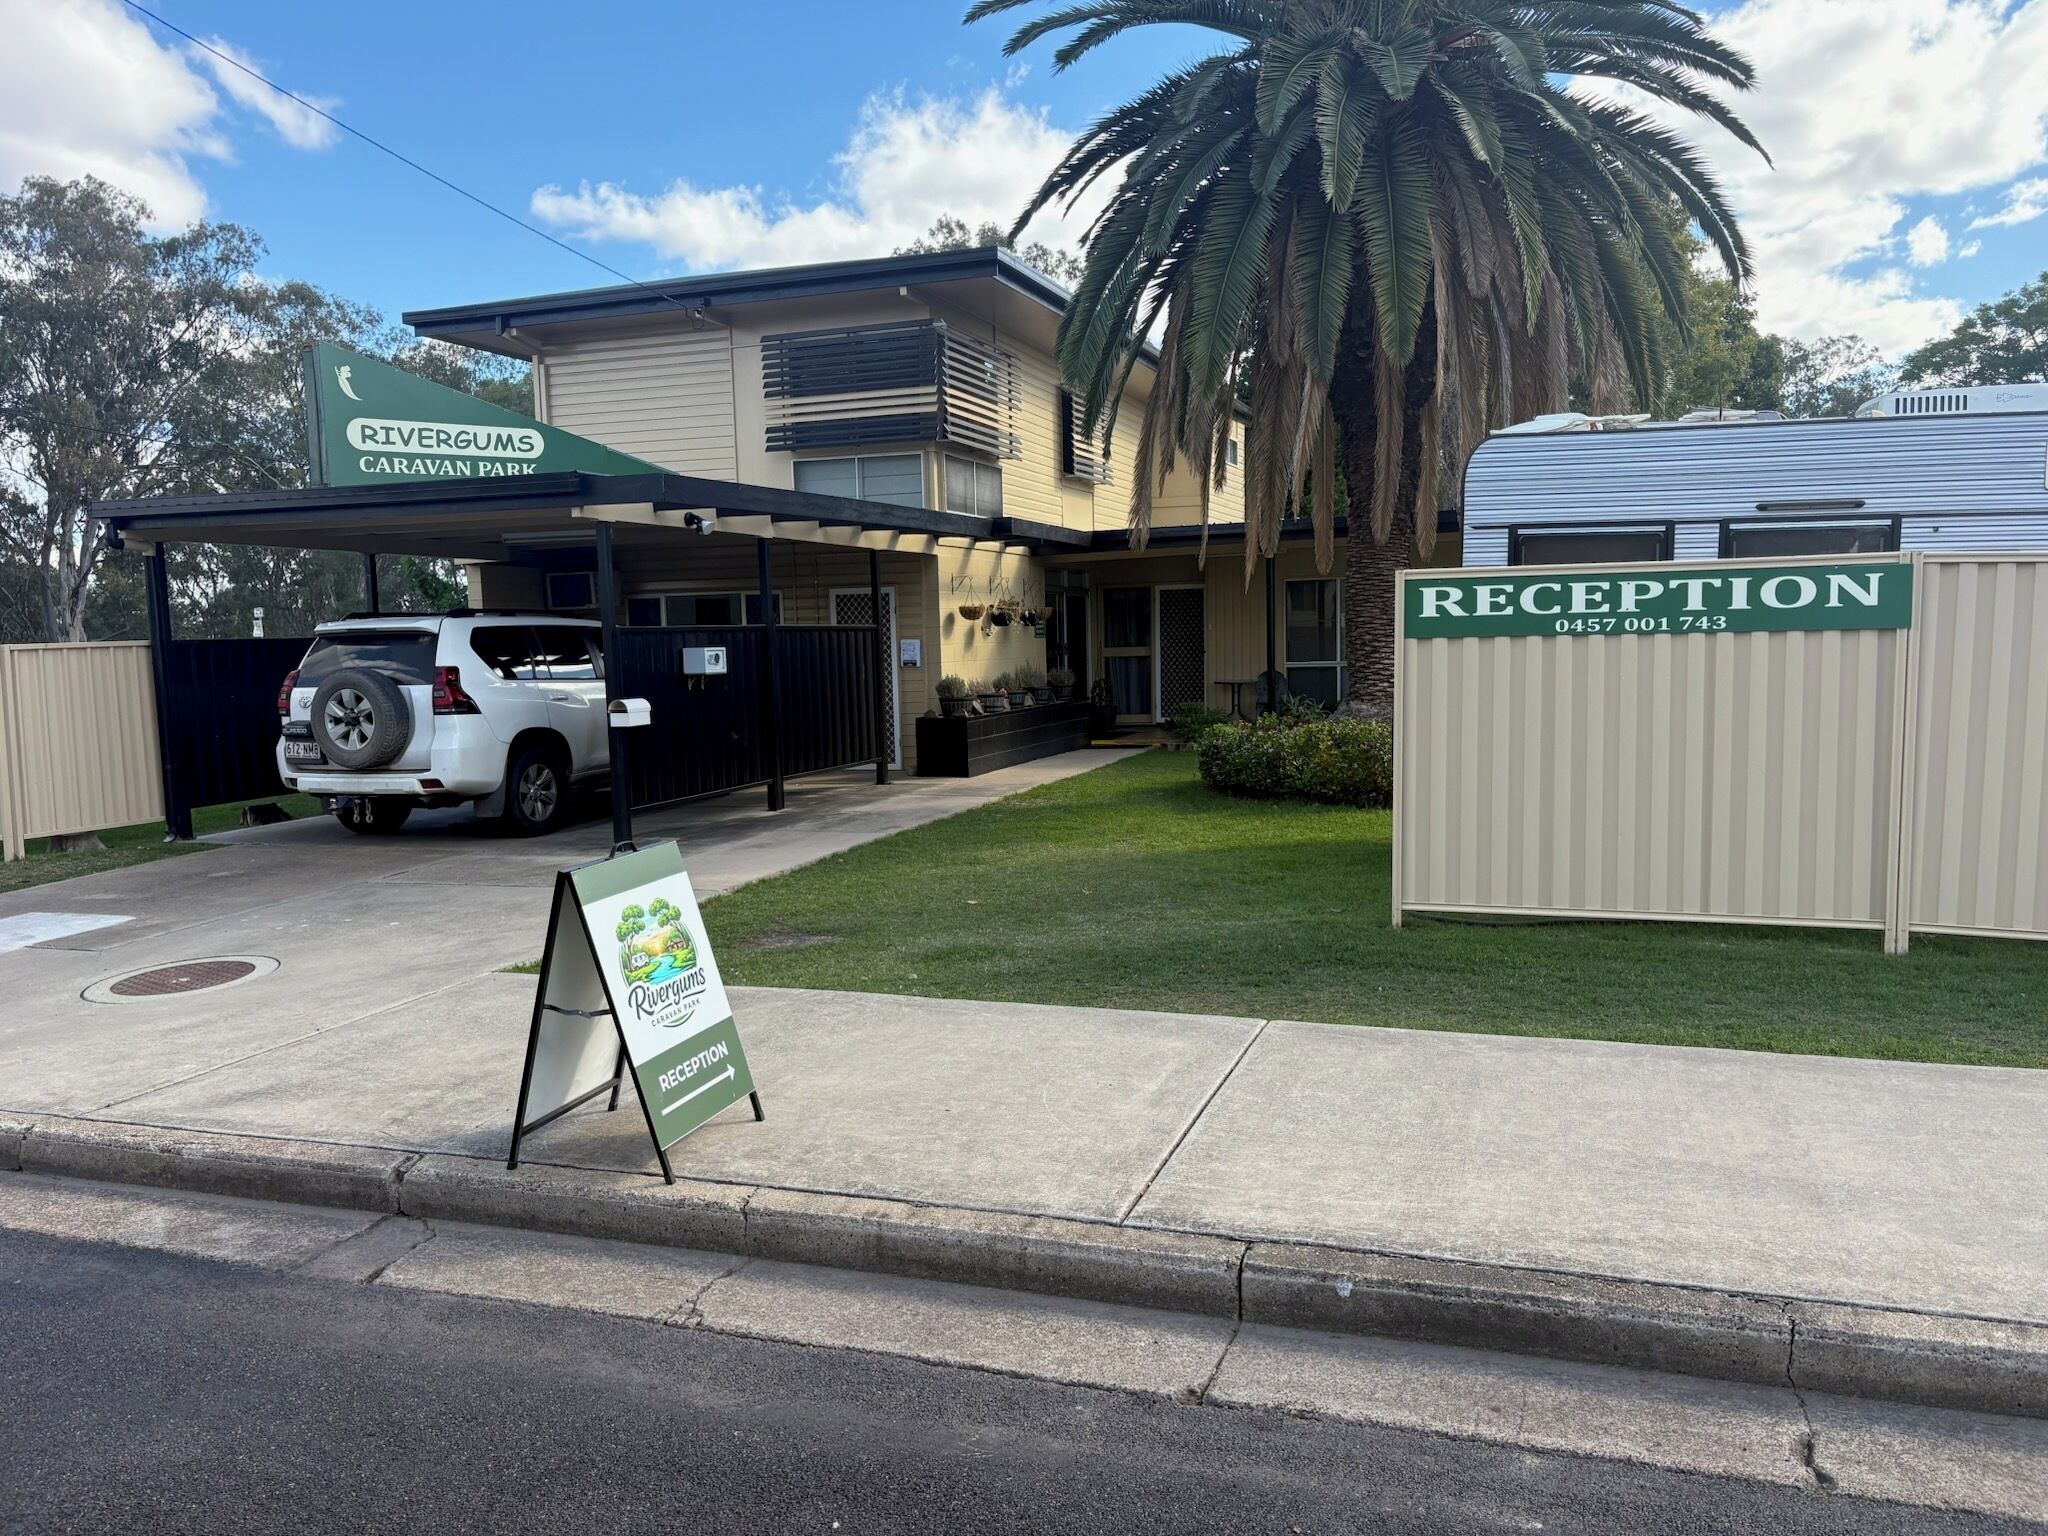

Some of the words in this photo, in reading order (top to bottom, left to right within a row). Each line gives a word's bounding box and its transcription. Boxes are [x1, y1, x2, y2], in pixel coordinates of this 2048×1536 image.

[360, 424, 535, 452] RIVERGUMS
[359, 456, 471, 477] CARAVAN
[478, 461, 537, 477] PARK
[1418, 572, 1884, 618] RECEPTION
[1555, 618, 1616, 633] 0457
[1624, 616, 1671, 632] 001
[1679, 615, 1727, 630] 743
[628, 967, 706, 1021] Rivergums
[651, 1007, 681, 1027] CARAVAN
[684, 997, 701, 1011] PARK
[658, 1040, 729, 1092] RECEPTION
